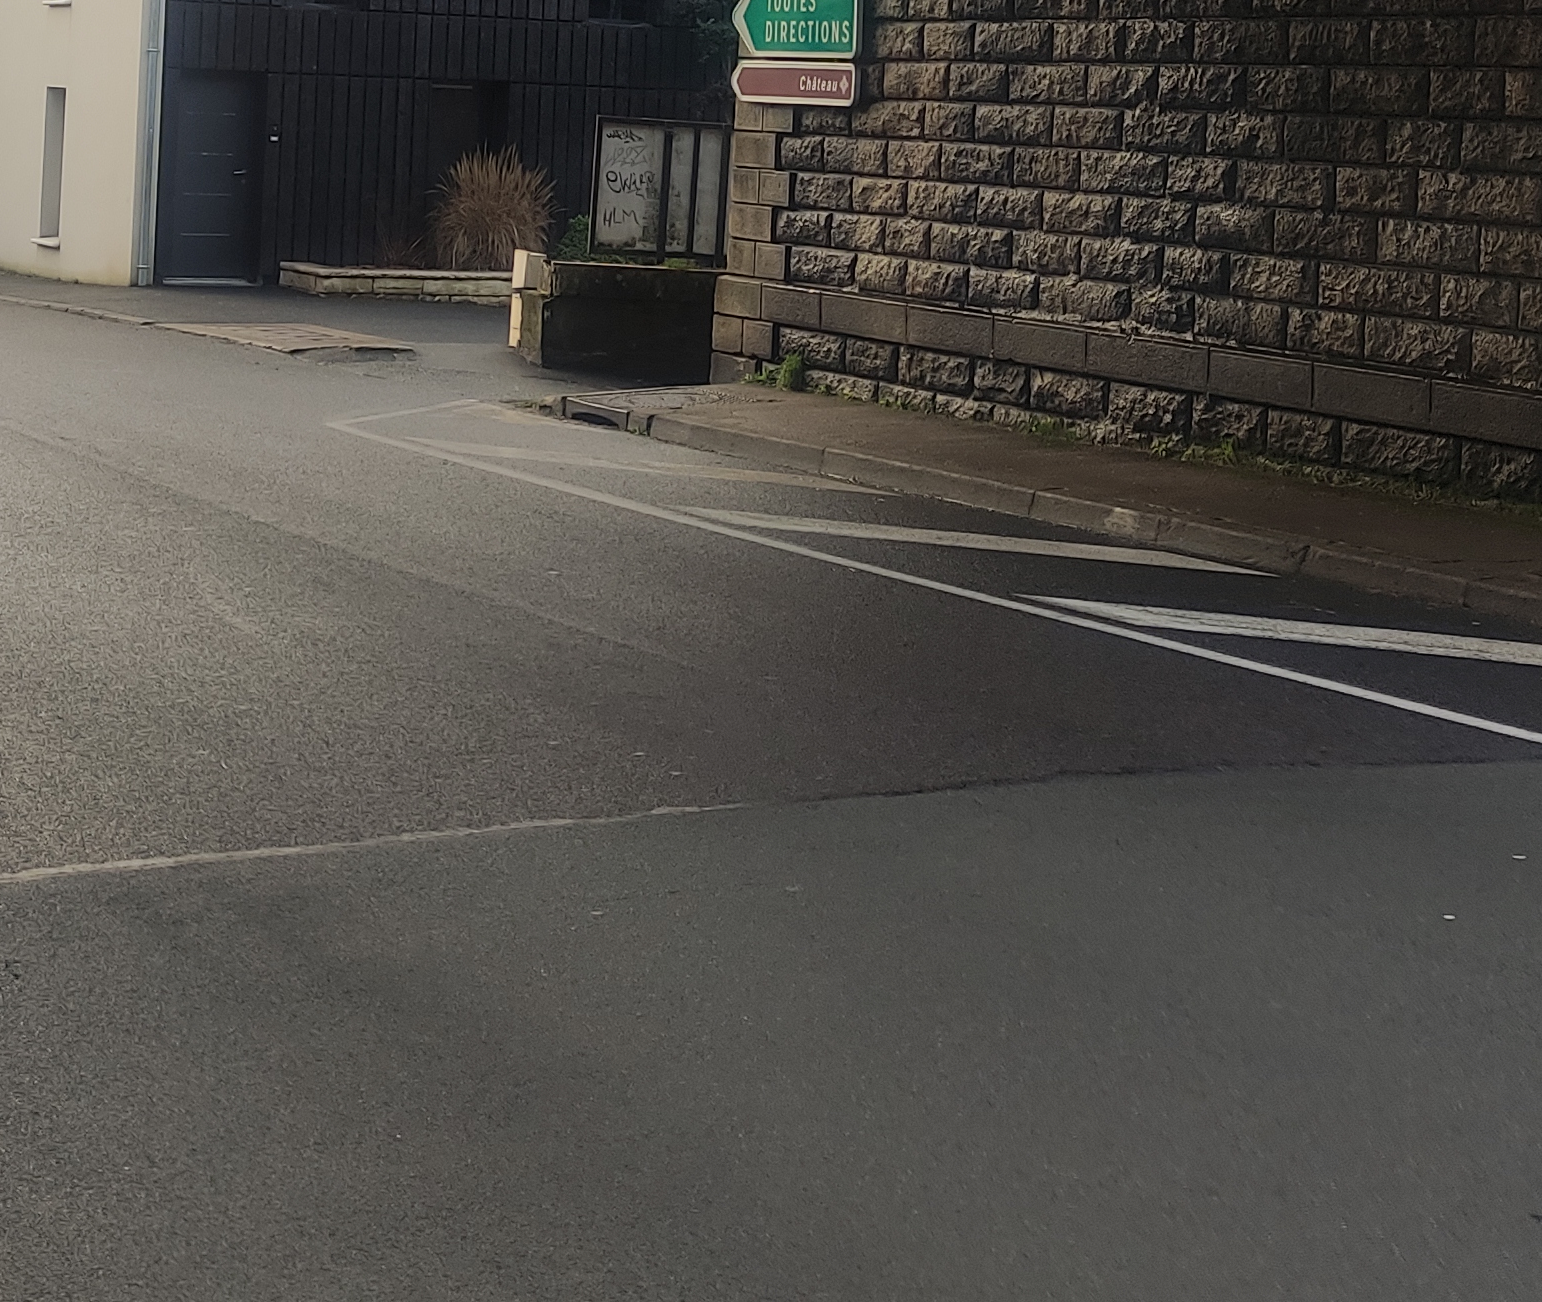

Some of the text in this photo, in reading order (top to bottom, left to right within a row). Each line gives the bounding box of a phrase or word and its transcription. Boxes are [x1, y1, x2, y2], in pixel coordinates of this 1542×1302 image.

[765, 20, 850, 43] DIRECTIONS
[799, 75, 838, 92] Château
[603, 206, 641, 228] HLM
